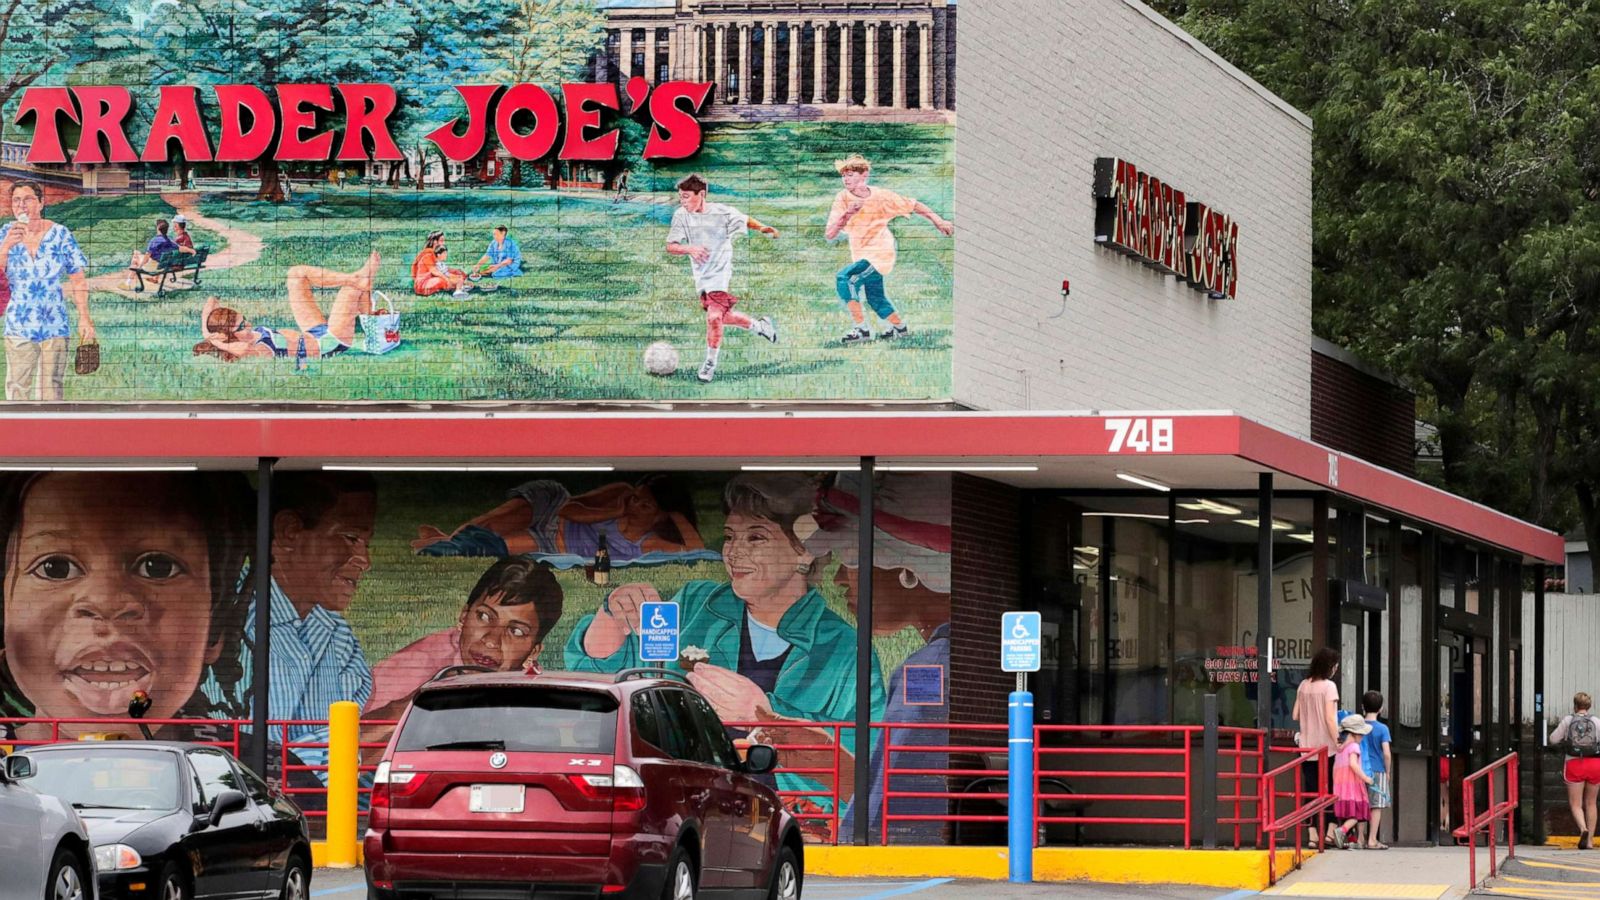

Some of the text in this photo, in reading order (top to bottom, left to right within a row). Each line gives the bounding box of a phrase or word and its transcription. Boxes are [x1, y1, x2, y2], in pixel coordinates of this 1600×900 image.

[14, 77, 714, 164] TRADER JOE'S
[1110, 156, 1240, 300] TRADER JOE'S
[1104, 418, 1174, 453] 748
[1209, 672, 1216, 683] 7
[1217, 672, 1241, 683] DAYS
[1242, 672, 1250, 683] A
[568, 758, 602, 767] X3
